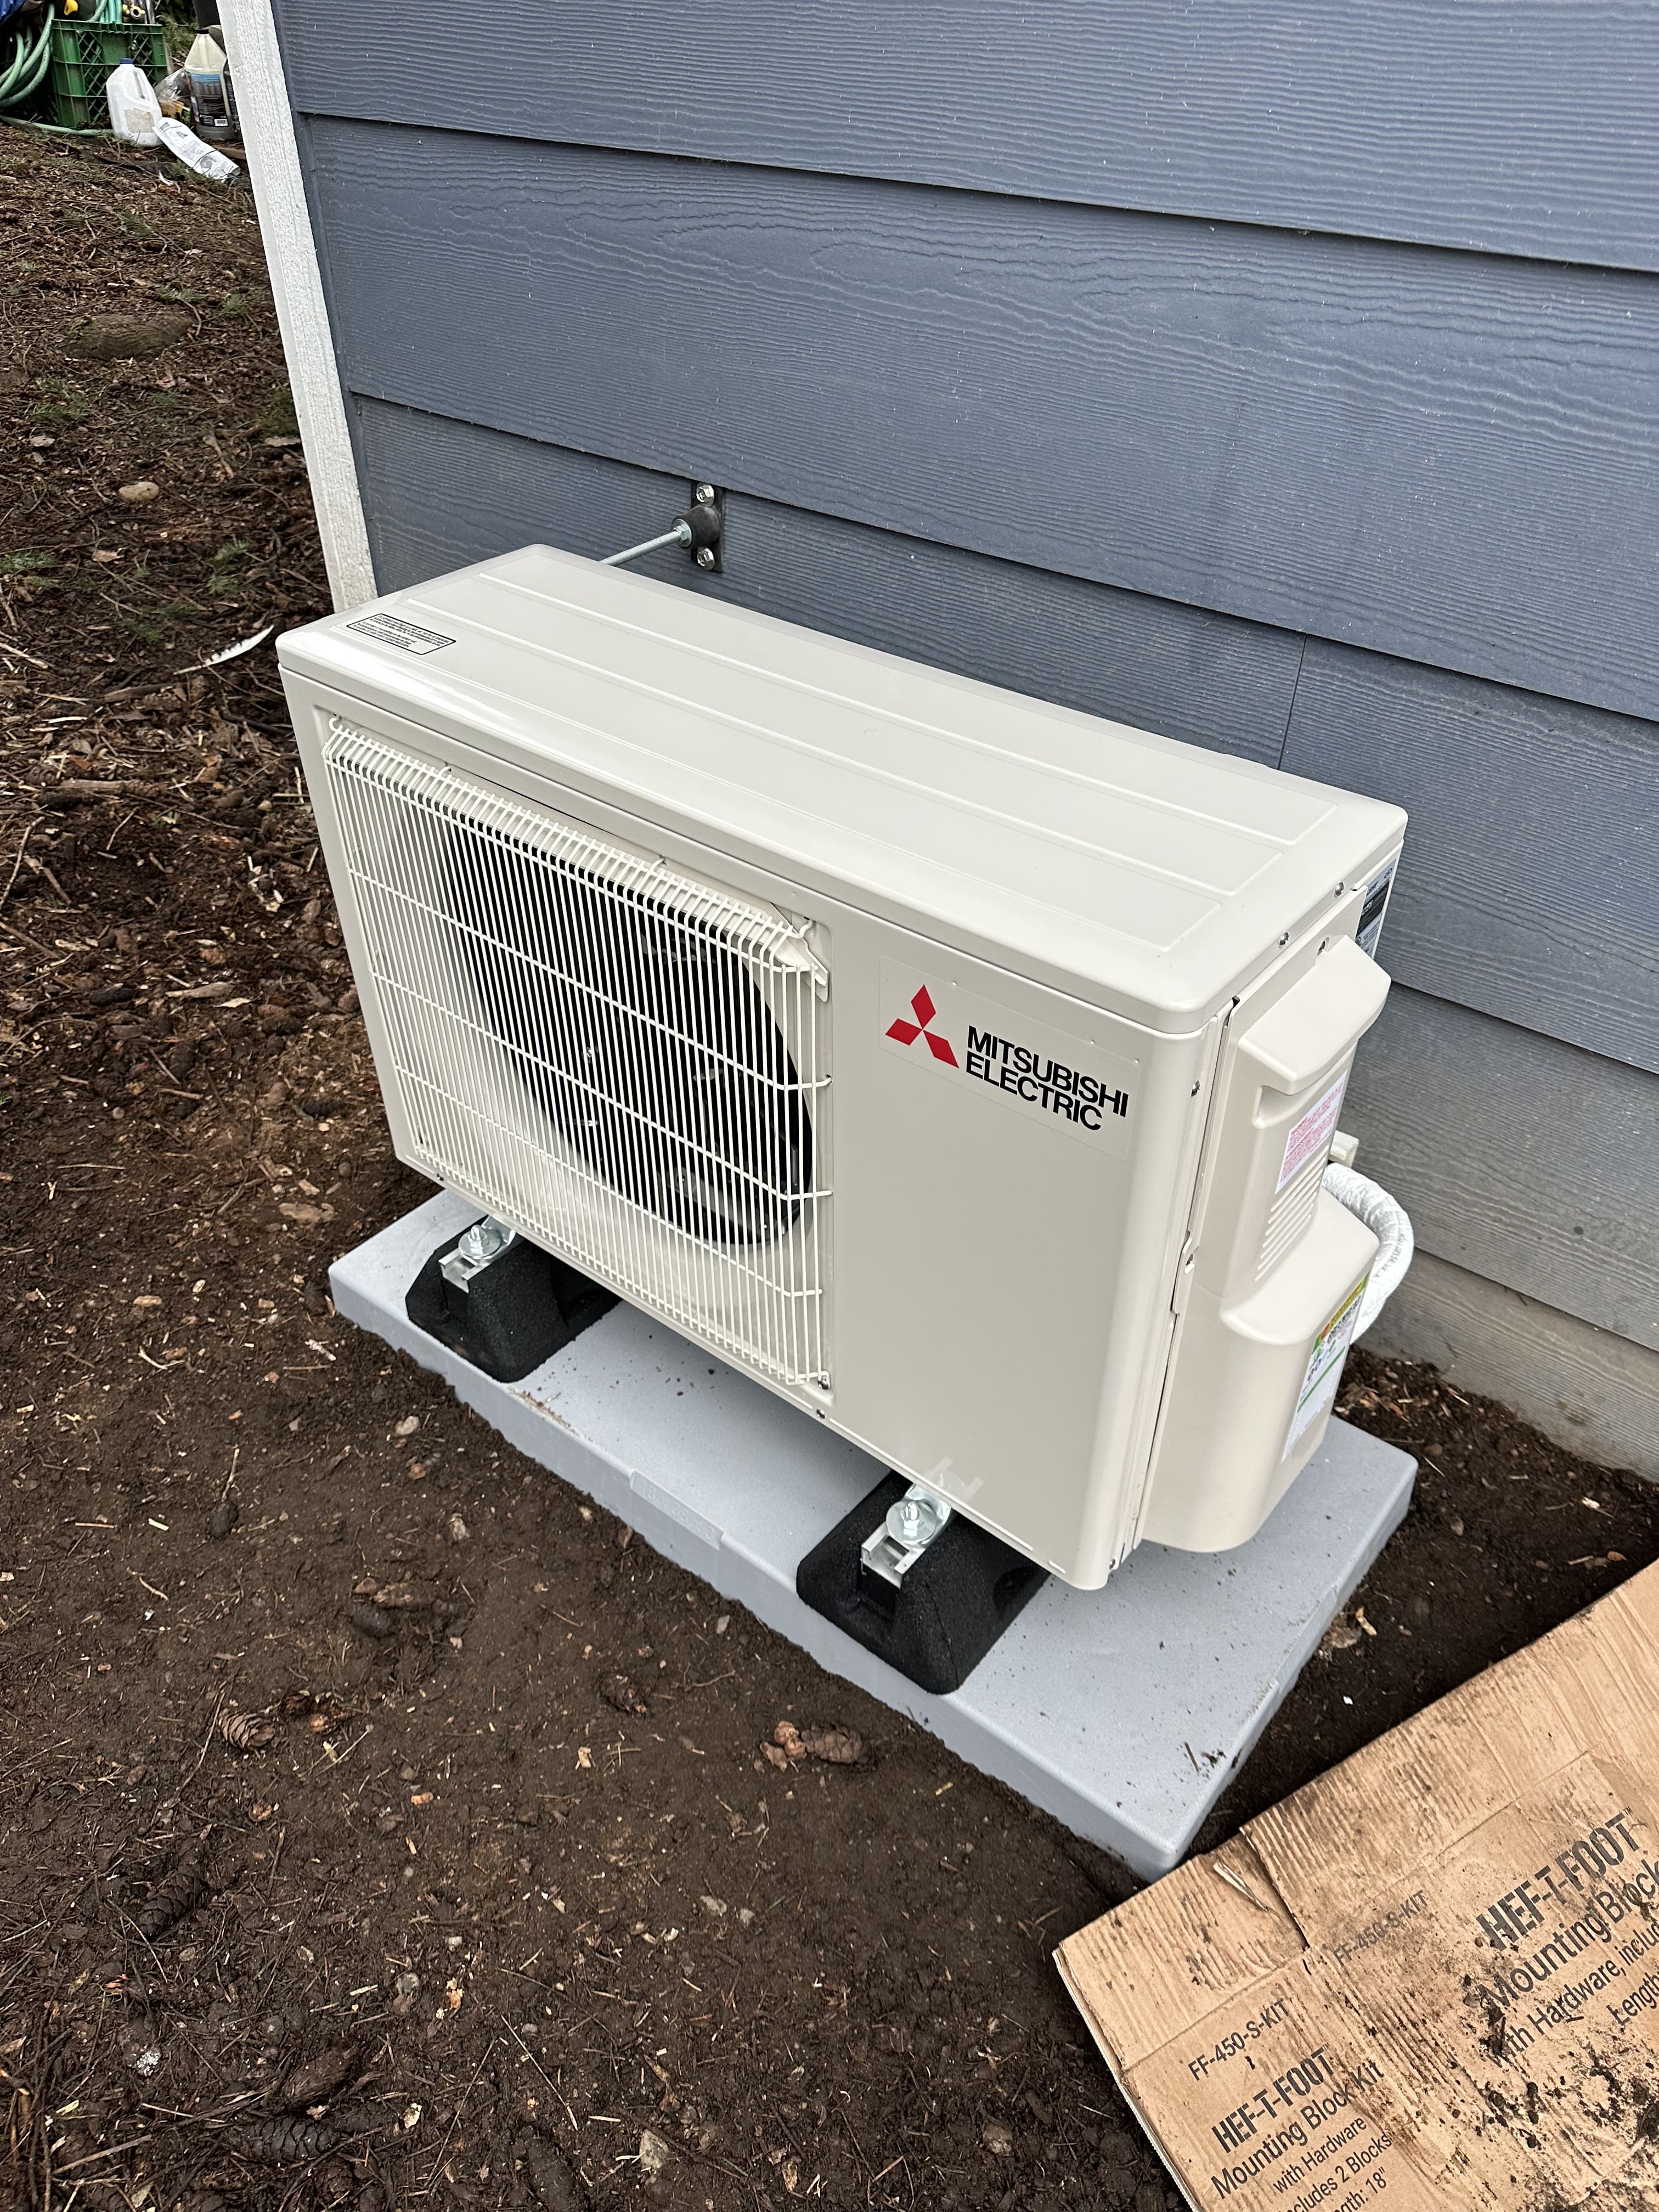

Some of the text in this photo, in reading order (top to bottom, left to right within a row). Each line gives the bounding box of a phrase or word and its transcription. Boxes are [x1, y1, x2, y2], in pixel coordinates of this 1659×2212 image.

[966, 1051, 1102, 1131] ELECTRIC
[968, 1025, 1128, 1118] MITSUBISHI
[1333, 1889, 1429, 1966] FF-450-S-KIT
[1477, 1912, 1612, 2010] Mounting
[1527, 1960, 1627, 2035] Hardware,
[1188, 1998, 1290, 2081] FF-450-S-KIT
[1211, 2059, 1385, 2200] Mounting Block Kit
[1273, 2118, 1367, 2194] with Hardware
[1335, 2165, 1350, 2183] 2
[1345, 2132, 1392, 2175] Blocks
[1365, 2166, 1386, 2194] 18"
